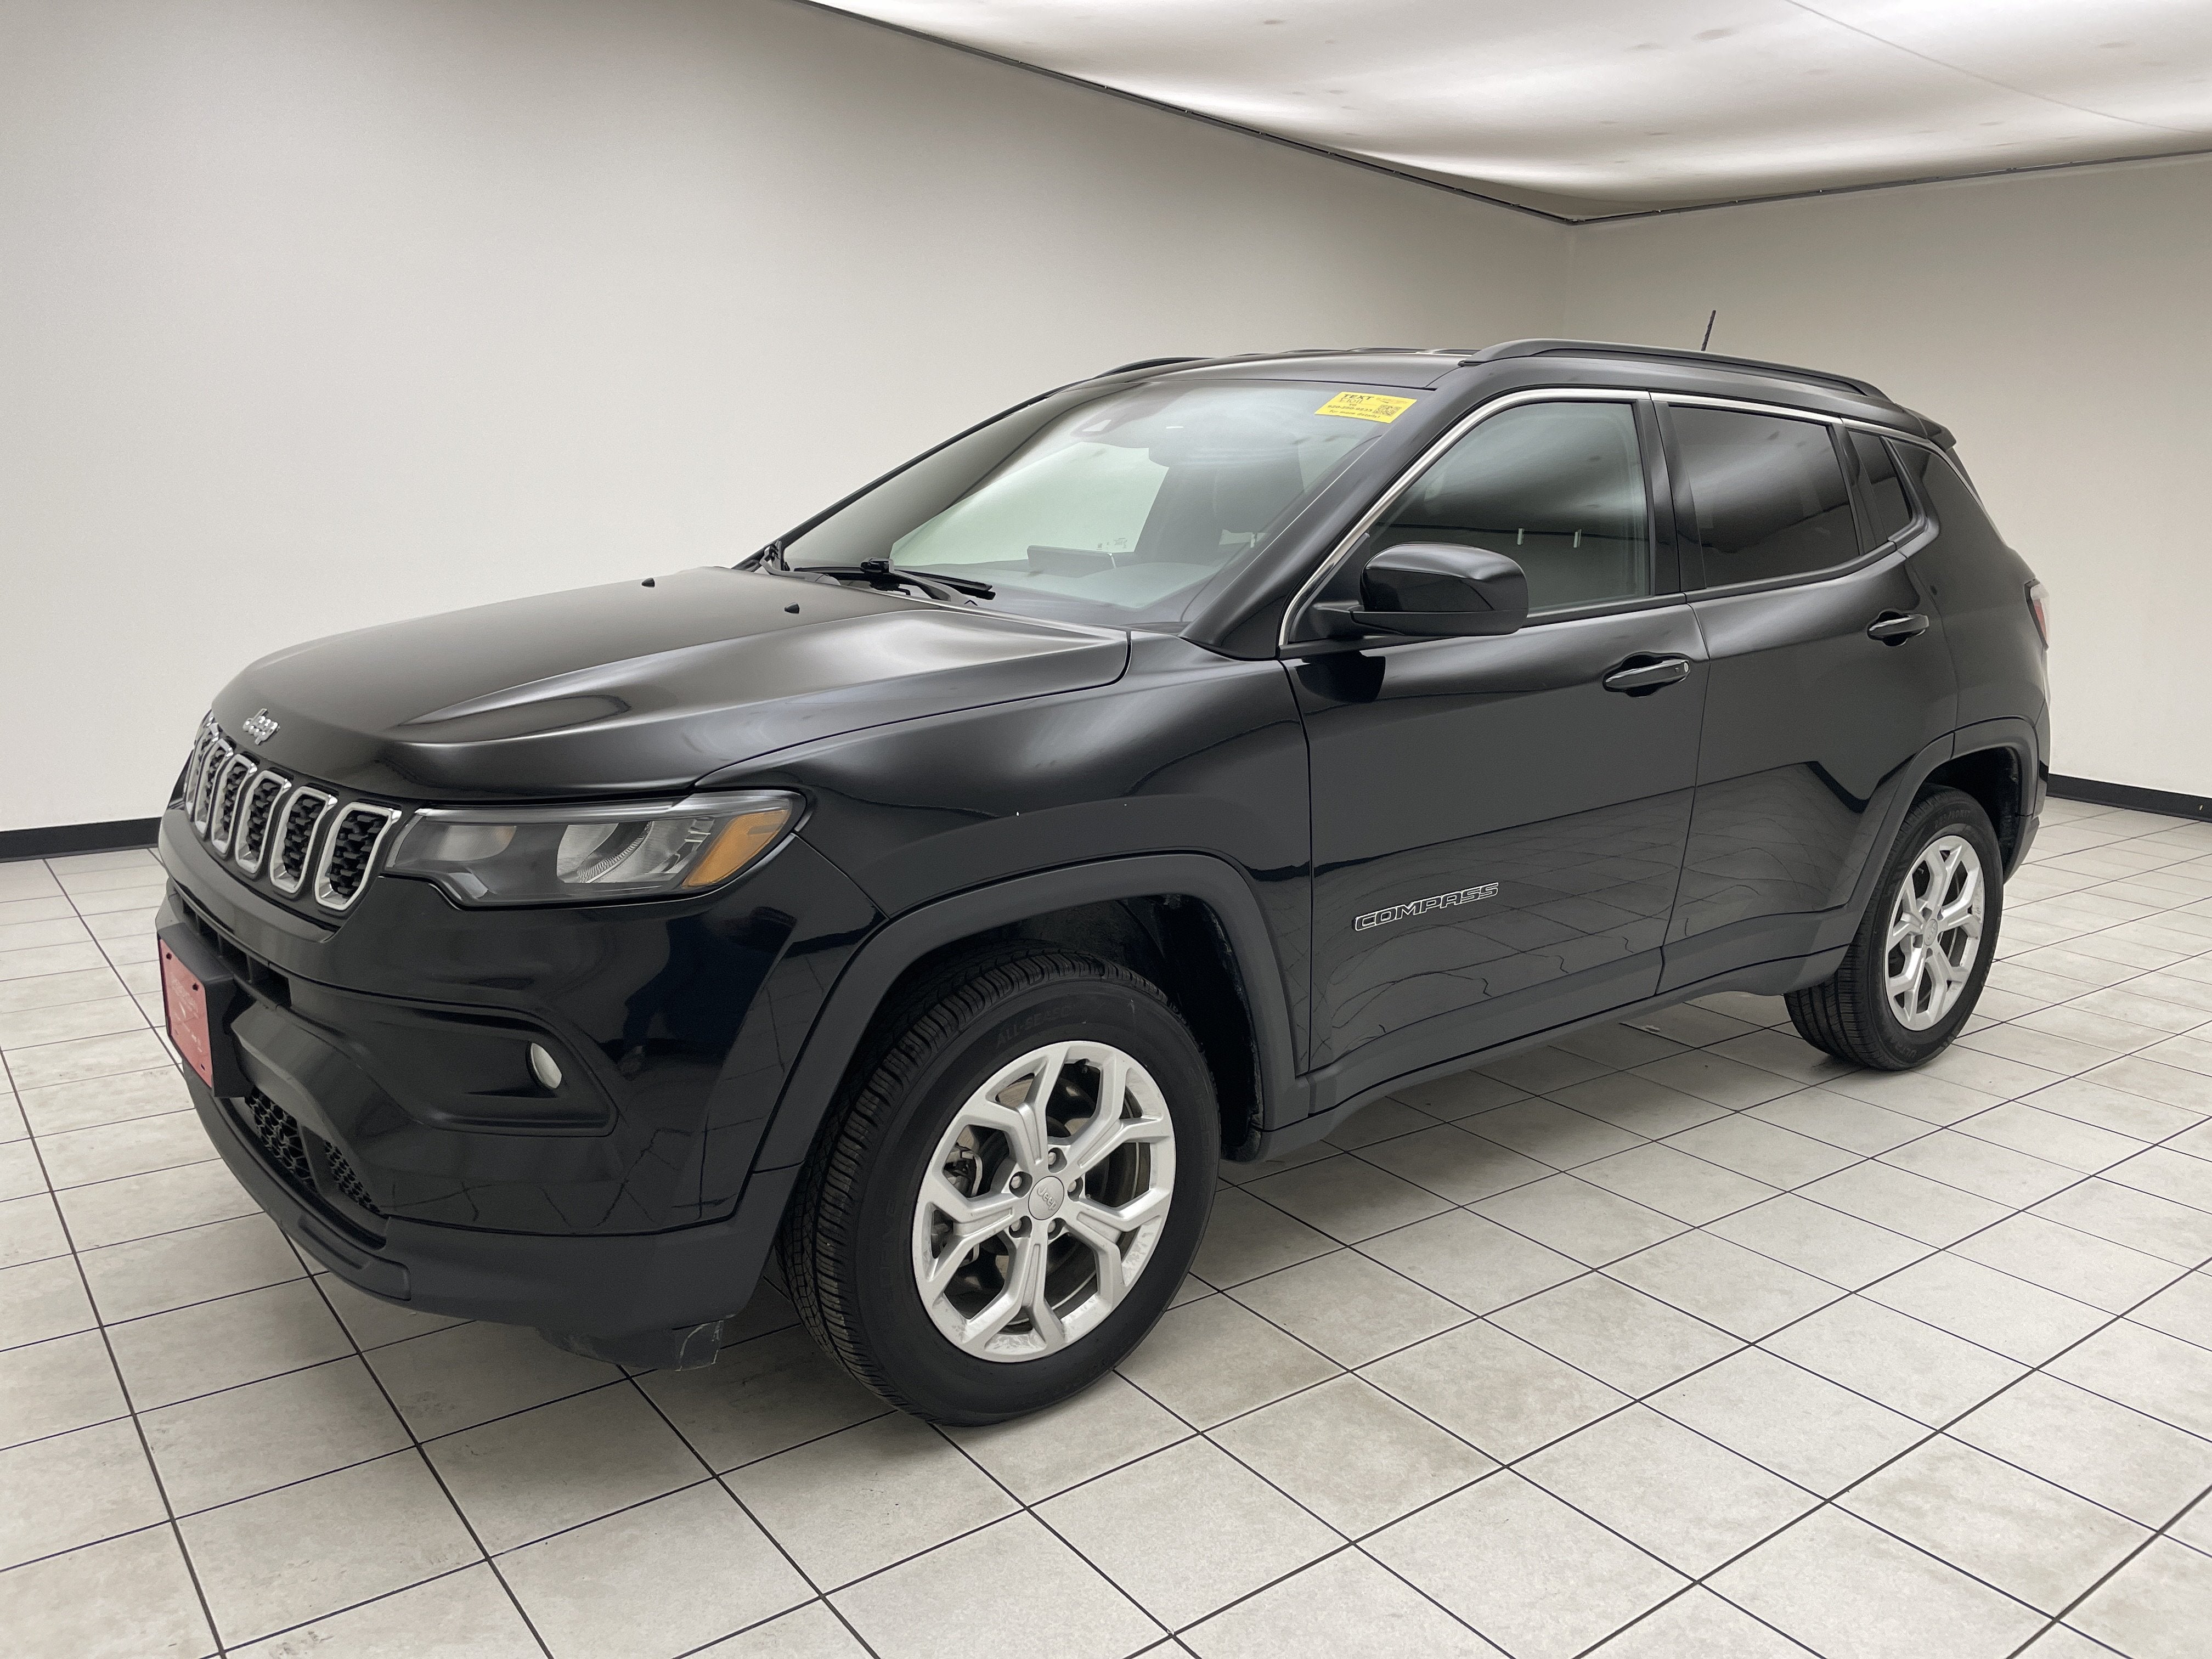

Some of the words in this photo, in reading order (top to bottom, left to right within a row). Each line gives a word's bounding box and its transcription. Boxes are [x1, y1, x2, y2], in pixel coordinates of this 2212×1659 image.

[242, 708, 280, 745] Jeep
[1352, 882, 1499, 931] COMPASS
[1037, 1186, 1058, 1210] Jeep
